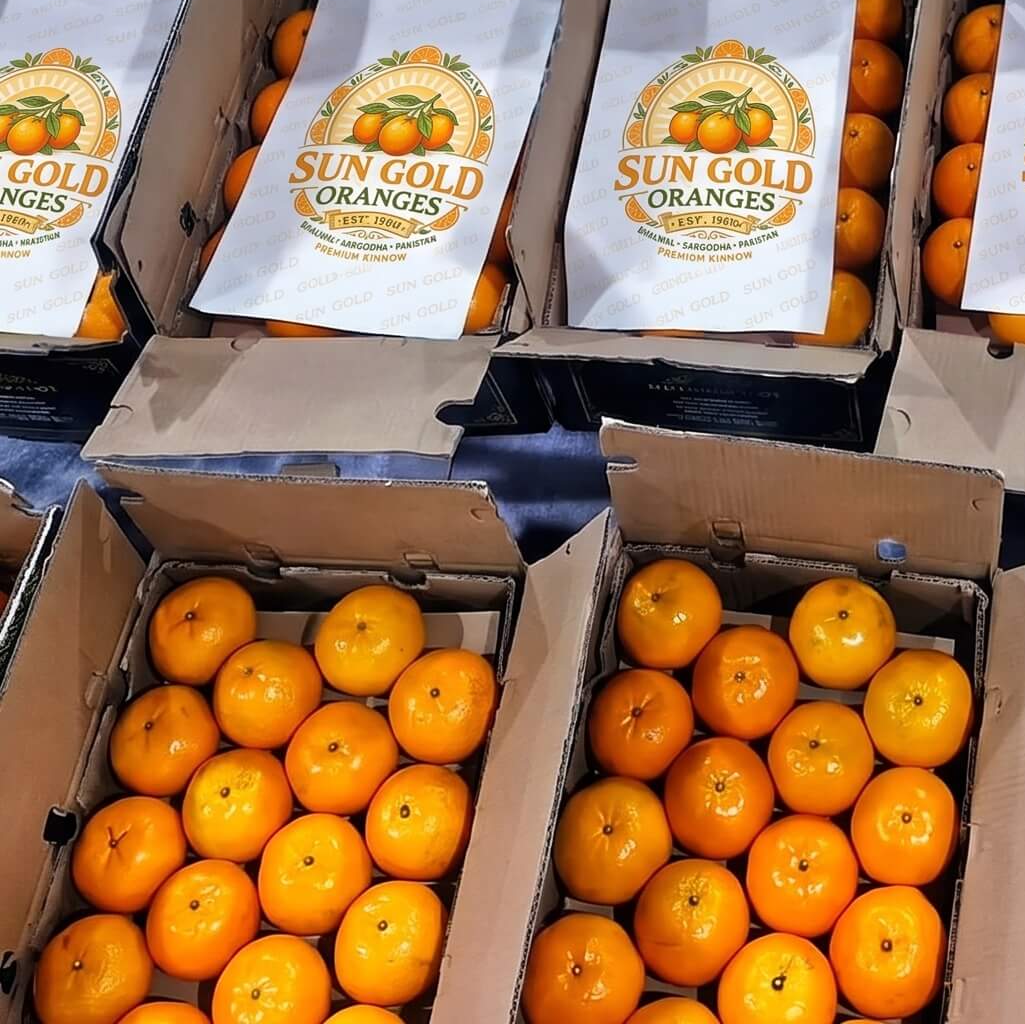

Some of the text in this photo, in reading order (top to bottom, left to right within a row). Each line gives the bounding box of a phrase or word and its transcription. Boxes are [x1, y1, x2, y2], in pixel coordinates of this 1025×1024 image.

[7, 159, 109, 197] GOLD
[288, 151, 484, 201] SUN GOLD
[614, 155, 814, 194] SUN GOLD
[315, 186, 442, 215] ORANGES
[648, 188, 775, 212] ORANGES
[314, 242, 408, 263] PREMIUM KINNOW
[682, 241, 732, 252] SARGODHA
[708, 251, 753, 263] KINNOW
